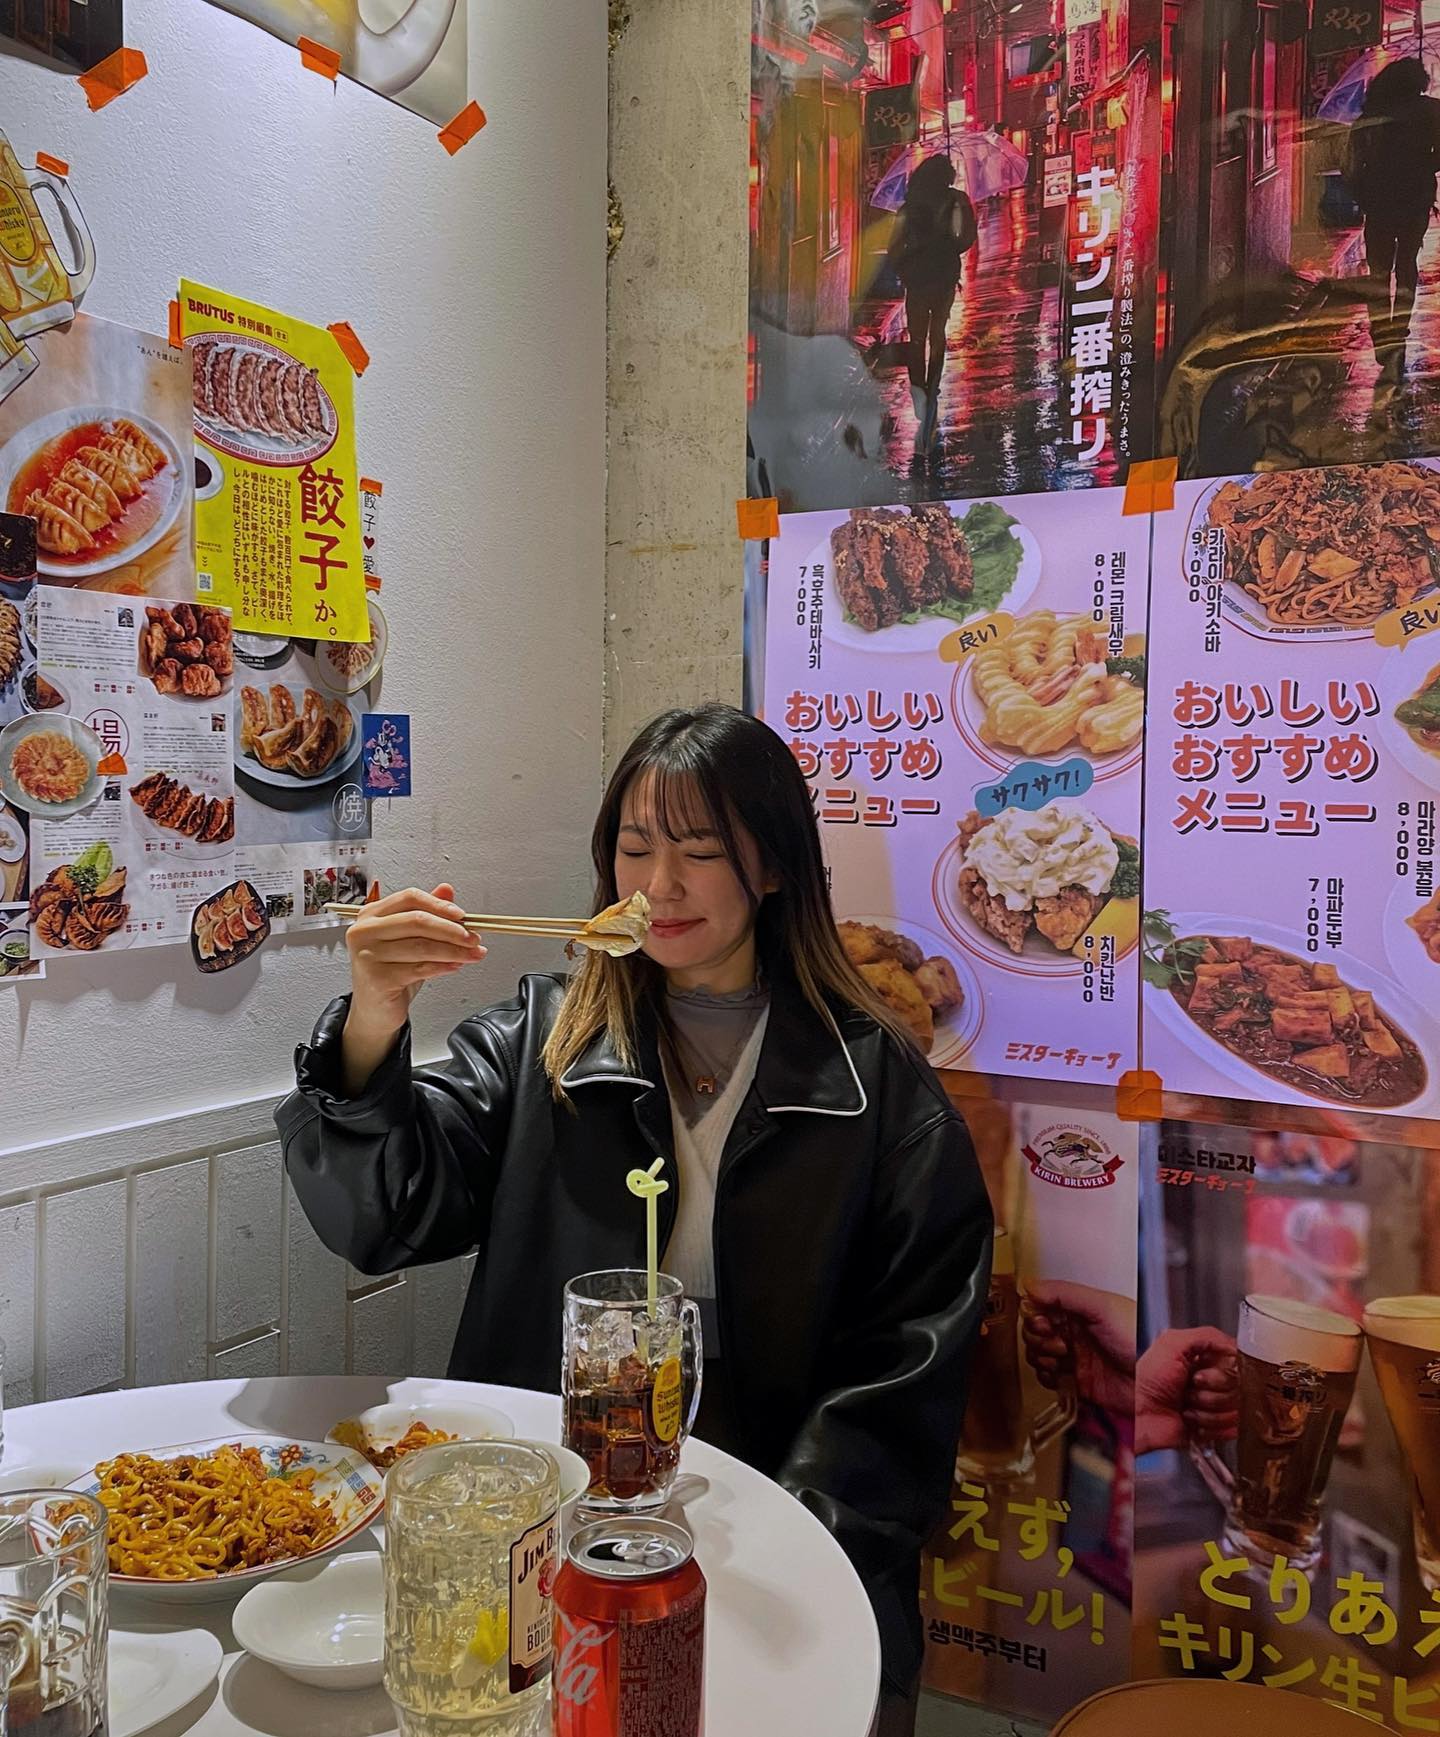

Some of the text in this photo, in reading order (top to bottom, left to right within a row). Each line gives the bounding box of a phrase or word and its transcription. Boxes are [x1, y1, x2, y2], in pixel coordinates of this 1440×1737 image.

[187, 297, 235, 324] BRUTUS
[1070, 165, 1117, 462] キリン一番搾り
[298, 463, 348, 636] 餃子か。
[1189, 531, 1202, 602] 9,000
[797, 566, 808, 625] 7,000
[1093, 554, 1105, 621] 8,000
[808, 564, 824, 669] 흑후추테바사키
[959, 624, 998, 653] 良い
[785, 690, 944, 732] おいしい
[1172, 680, 1380, 727] おいしい
[1171, 733, 1378, 783] おすすめ
[338, 791, 364, 825] 焼
[1172, 787, 1376, 837] メニュー
[1396, 802, 1410, 876] 8,000
[1307, 878, 1320, 952] 7,000
[1326, 878, 1344, 948] 마파두부
[1083, 936, 1094, 1002] 8,000
[1100, 936, 1115, 1002] 치킨난반
[1034, 1166, 1110, 1187] KIRIN BREWERY
[1158, 1145, 1256, 1174] 미스타교자
[518, 1539, 544, 1584] JIM
[928, 1618, 1047, 1673] 생맥주부터
